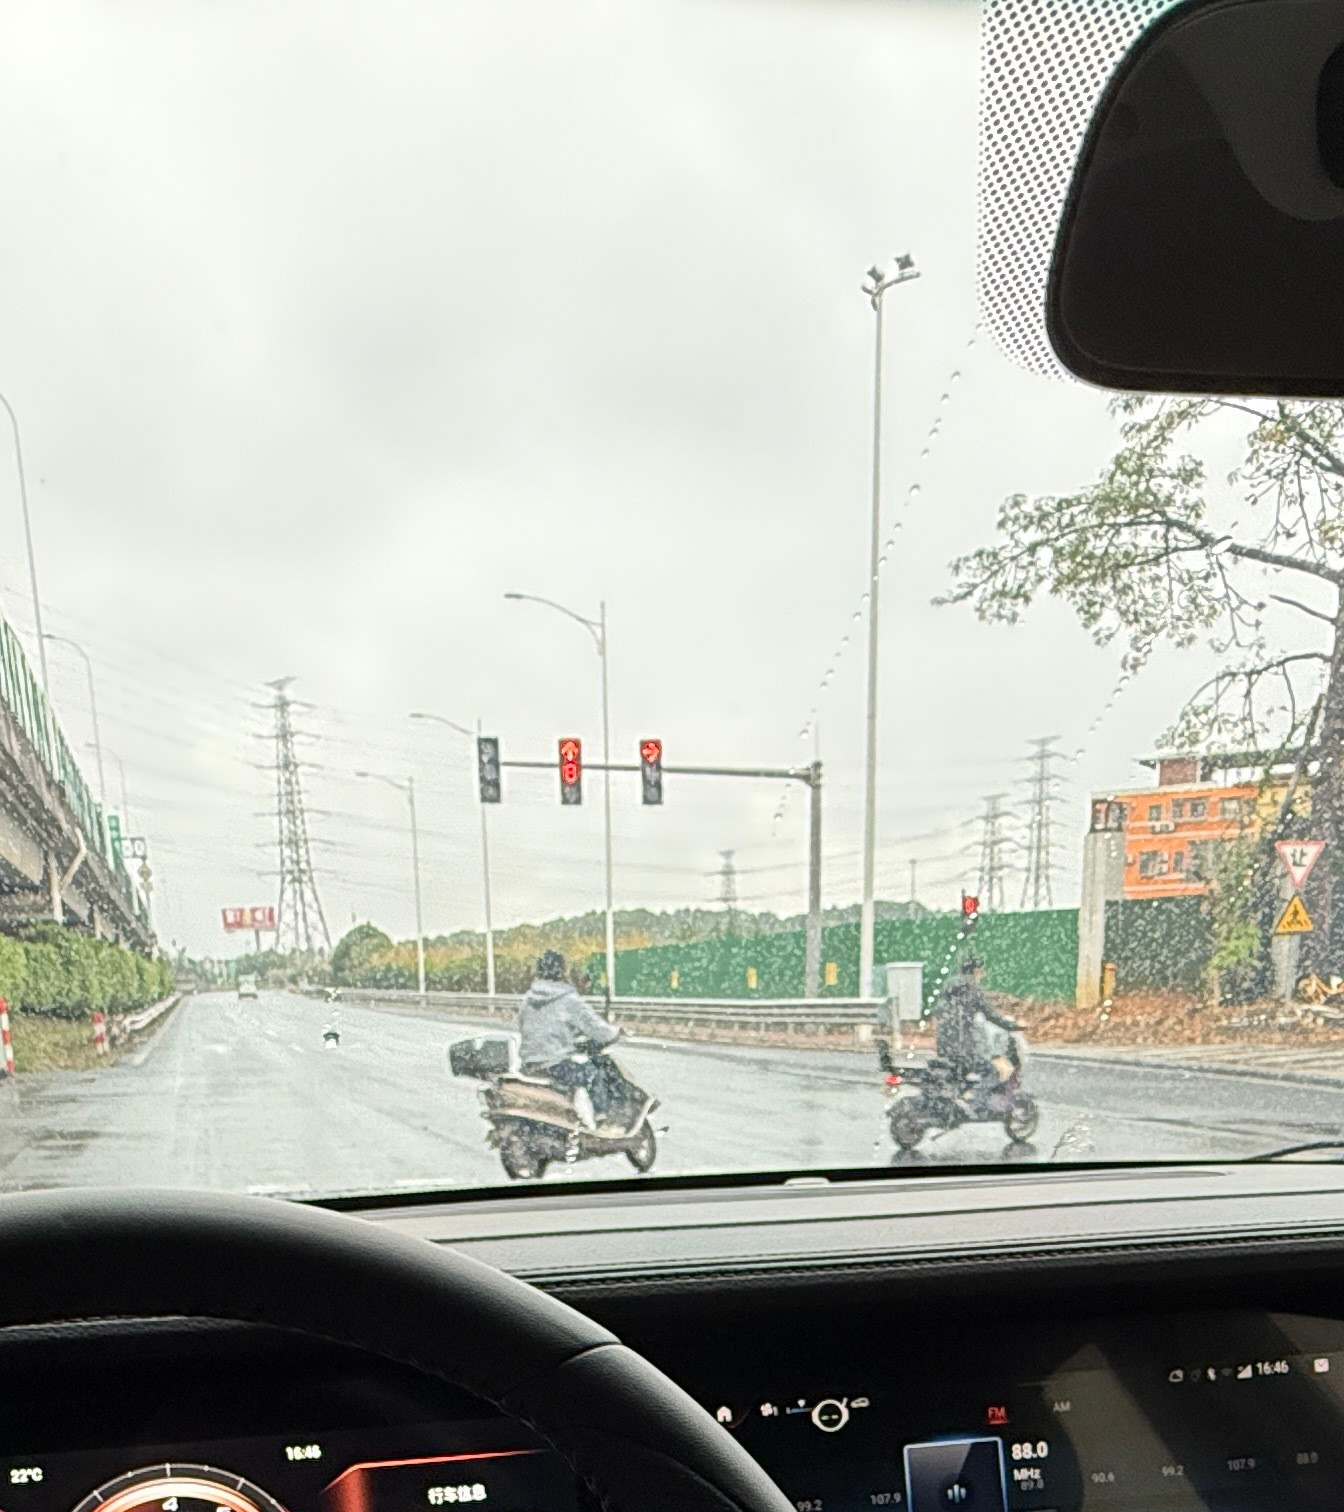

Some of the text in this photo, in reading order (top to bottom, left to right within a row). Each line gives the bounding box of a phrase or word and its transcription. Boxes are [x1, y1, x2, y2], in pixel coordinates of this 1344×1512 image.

[1255, 1359, 1290, 1375] 16:46
[987, 1406, 1007, 1419] FM
[1011, 1440, 1049, 1461] 88.0
[1227, 1458, 1256, 1472] 107.9
[9, 1466, 44, 1484] 22°C
[1012, 1467, 1042, 1481] MHz
[161, 1496, 179, 1512] 4
[869, 1492, 903, 1506] 107.9
